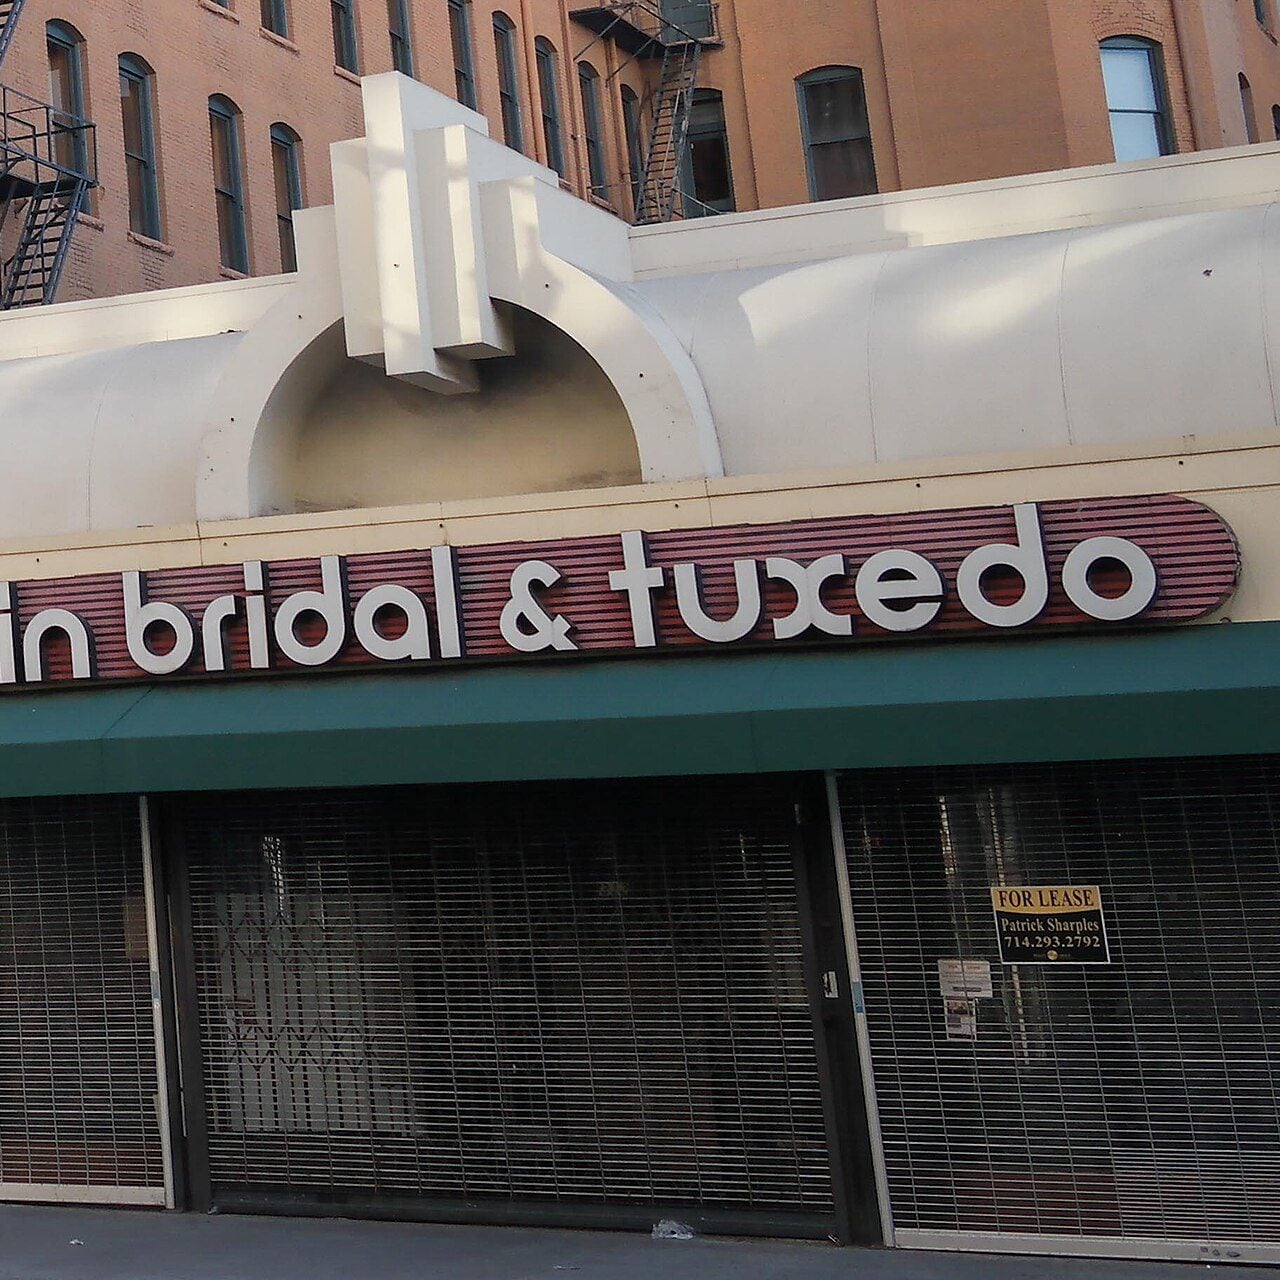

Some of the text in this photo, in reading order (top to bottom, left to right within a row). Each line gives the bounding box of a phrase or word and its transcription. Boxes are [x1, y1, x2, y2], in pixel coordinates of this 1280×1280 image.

[121, 545, 463, 676] bridal
[499, 559, 580, 653] &
[607, 502, 1158, 650] tuxedo
[998, 889, 1094, 907] FOR LEASE
[1001, 917, 1099, 934] Patrick Sharples
[1004, 935, 1100, 948] 714.293.2792
